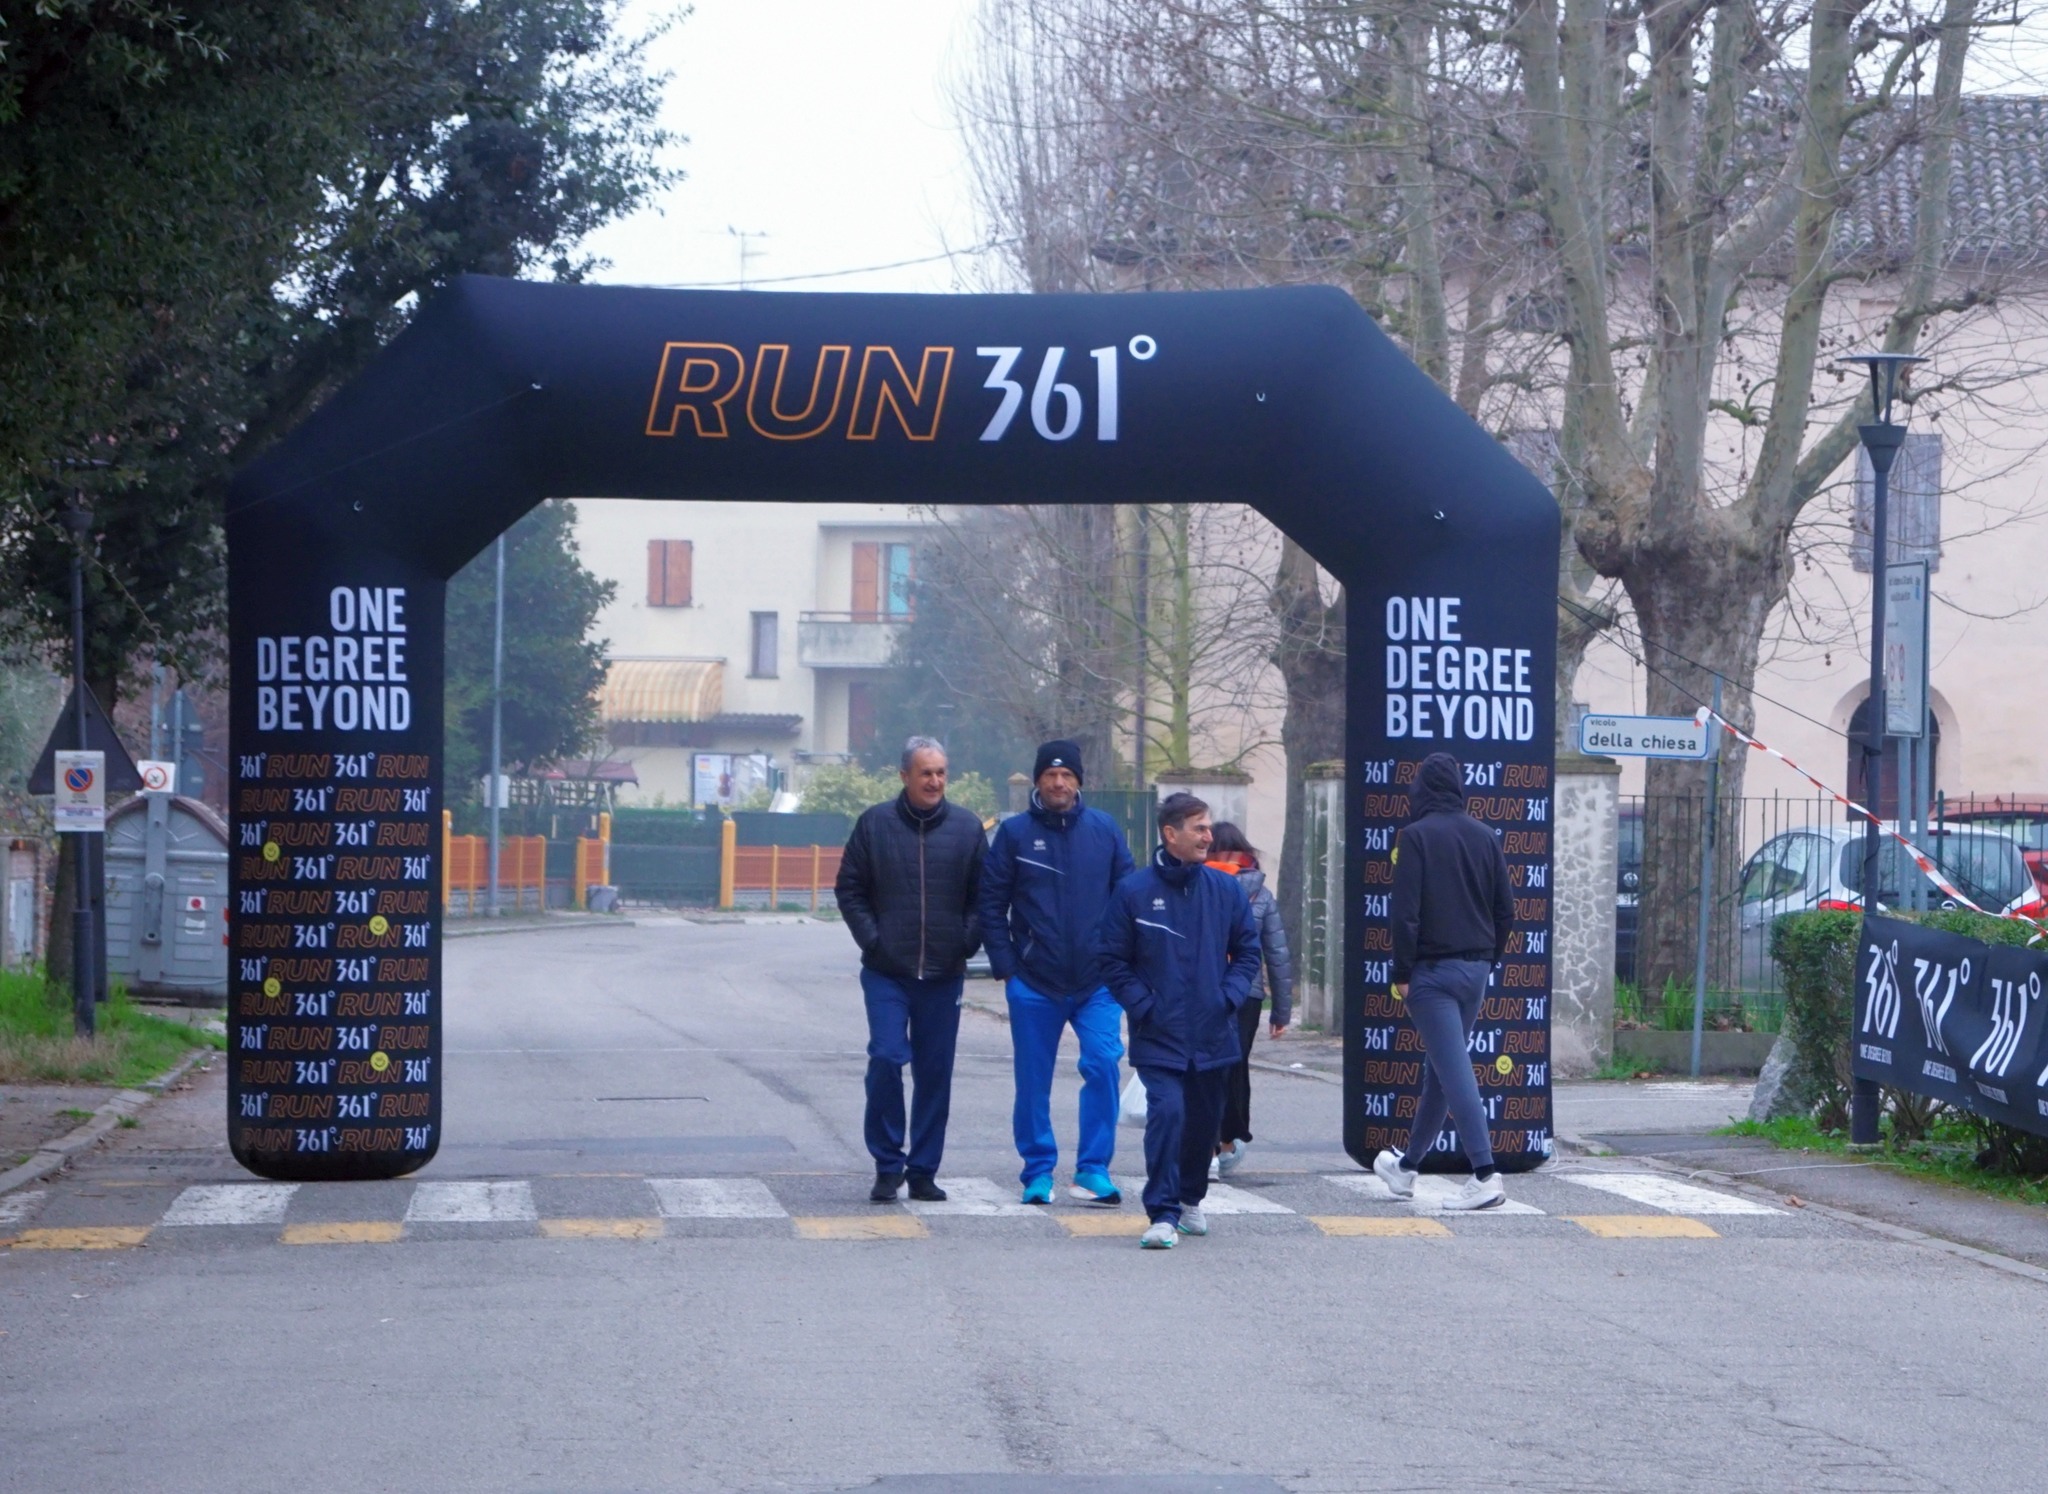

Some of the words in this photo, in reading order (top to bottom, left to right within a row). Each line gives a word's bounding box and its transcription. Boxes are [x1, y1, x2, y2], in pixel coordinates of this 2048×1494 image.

[645, 341, 954, 441] RUN
[976, 334, 1157, 441] 361°
[330, 586, 407, 632] ONE
[1386, 596, 1461, 641] ONE
[257, 635, 407, 681] DEGREE
[1386, 645, 1531, 693] DEGREE
[258, 685, 410, 731] BEYOND
[1386, 694, 1534, 741] BEYOND
[1590, 718, 1617, 727] vicolo
[1589, 732, 1633, 748] della
[1641, 735, 1697, 751] chiesa
[240, 752, 267, 778] 361°
[266, 754, 330, 778] RUN
[334, 752, 375, 778] 361°
[376, 755, 430, 778] RUN
[1365, 759, 1395, 784] 361°
[1464, 762, 1502, 786] 361°
[1504, 764, 1548, 788] RUN
[293, 785, 334, 811] 361°
[335, 788, 400, 812] RUN
[1466, 797, 1524, 820] RUN
[240, 820, 267, 846] 361°
[267, 823, 330, 846] RUN
[334, 820, 376, 846] 361°
[376, 823, 430, 846] RUN
[1364, 826, 1394, 850] 361°
[1504, 831, 1547, 854] RUN
[293, 854, 334, 880] 361°
[335, 857, 400, 880] RUN
[1364, 861, 1394, 884] RU
[240, 888, 267, 914] 361°
[267, 891, 331, 914] RUN
[335, 888, 376, 914] 361°
[377, 891, 430, 914] RUN
[294, 922, 335, 948] 361°
[336, 925, 401, 948] RUN
[1364, 928, 1393, 951] RU
[240, 956, 267, 981] 361°
[268, 959, 332, 982] RUN
[335, 956, 376, 981] 361°
[377, 959, 429, 981] RUN
[1364, 959, 1394, 984] 361°
[1503, 964, 1546, 987] RUN
[294, 990, 336, 1016] 361°
[337, 993, 401, 1016] RUN
[240, 1024, 268, 1050] 361°
[268, 1027, 332, 1050] RUN
[336, 1024, 377, 1050] 361°
[378, 1026, 430, 1049] RUN
[1364, 1026, 1395, 1050] 361°
[1503, 1031, 1546, 1054] RUN
[295, 1058, 336, 1084] 361°
[338, 1061, 402, 1083] RUN
[1364, 1061, 1419, 1085] RUN
[240, 1092, 268, 1117] 361°
[268, 1095, 333, 1118] RUN
[337, 1092, 377, 1118] 361°
[379, 1094, 430, 1117] RUN
[1364, 1092, 1395, 1117] 361°
[1504, 1097, 1547, 1120] RUN
[296, 1126, 337, 1152] 361°
[339, 1129, 403, 1151] RUN
[1489, 1130, 1524, 1152] UN
